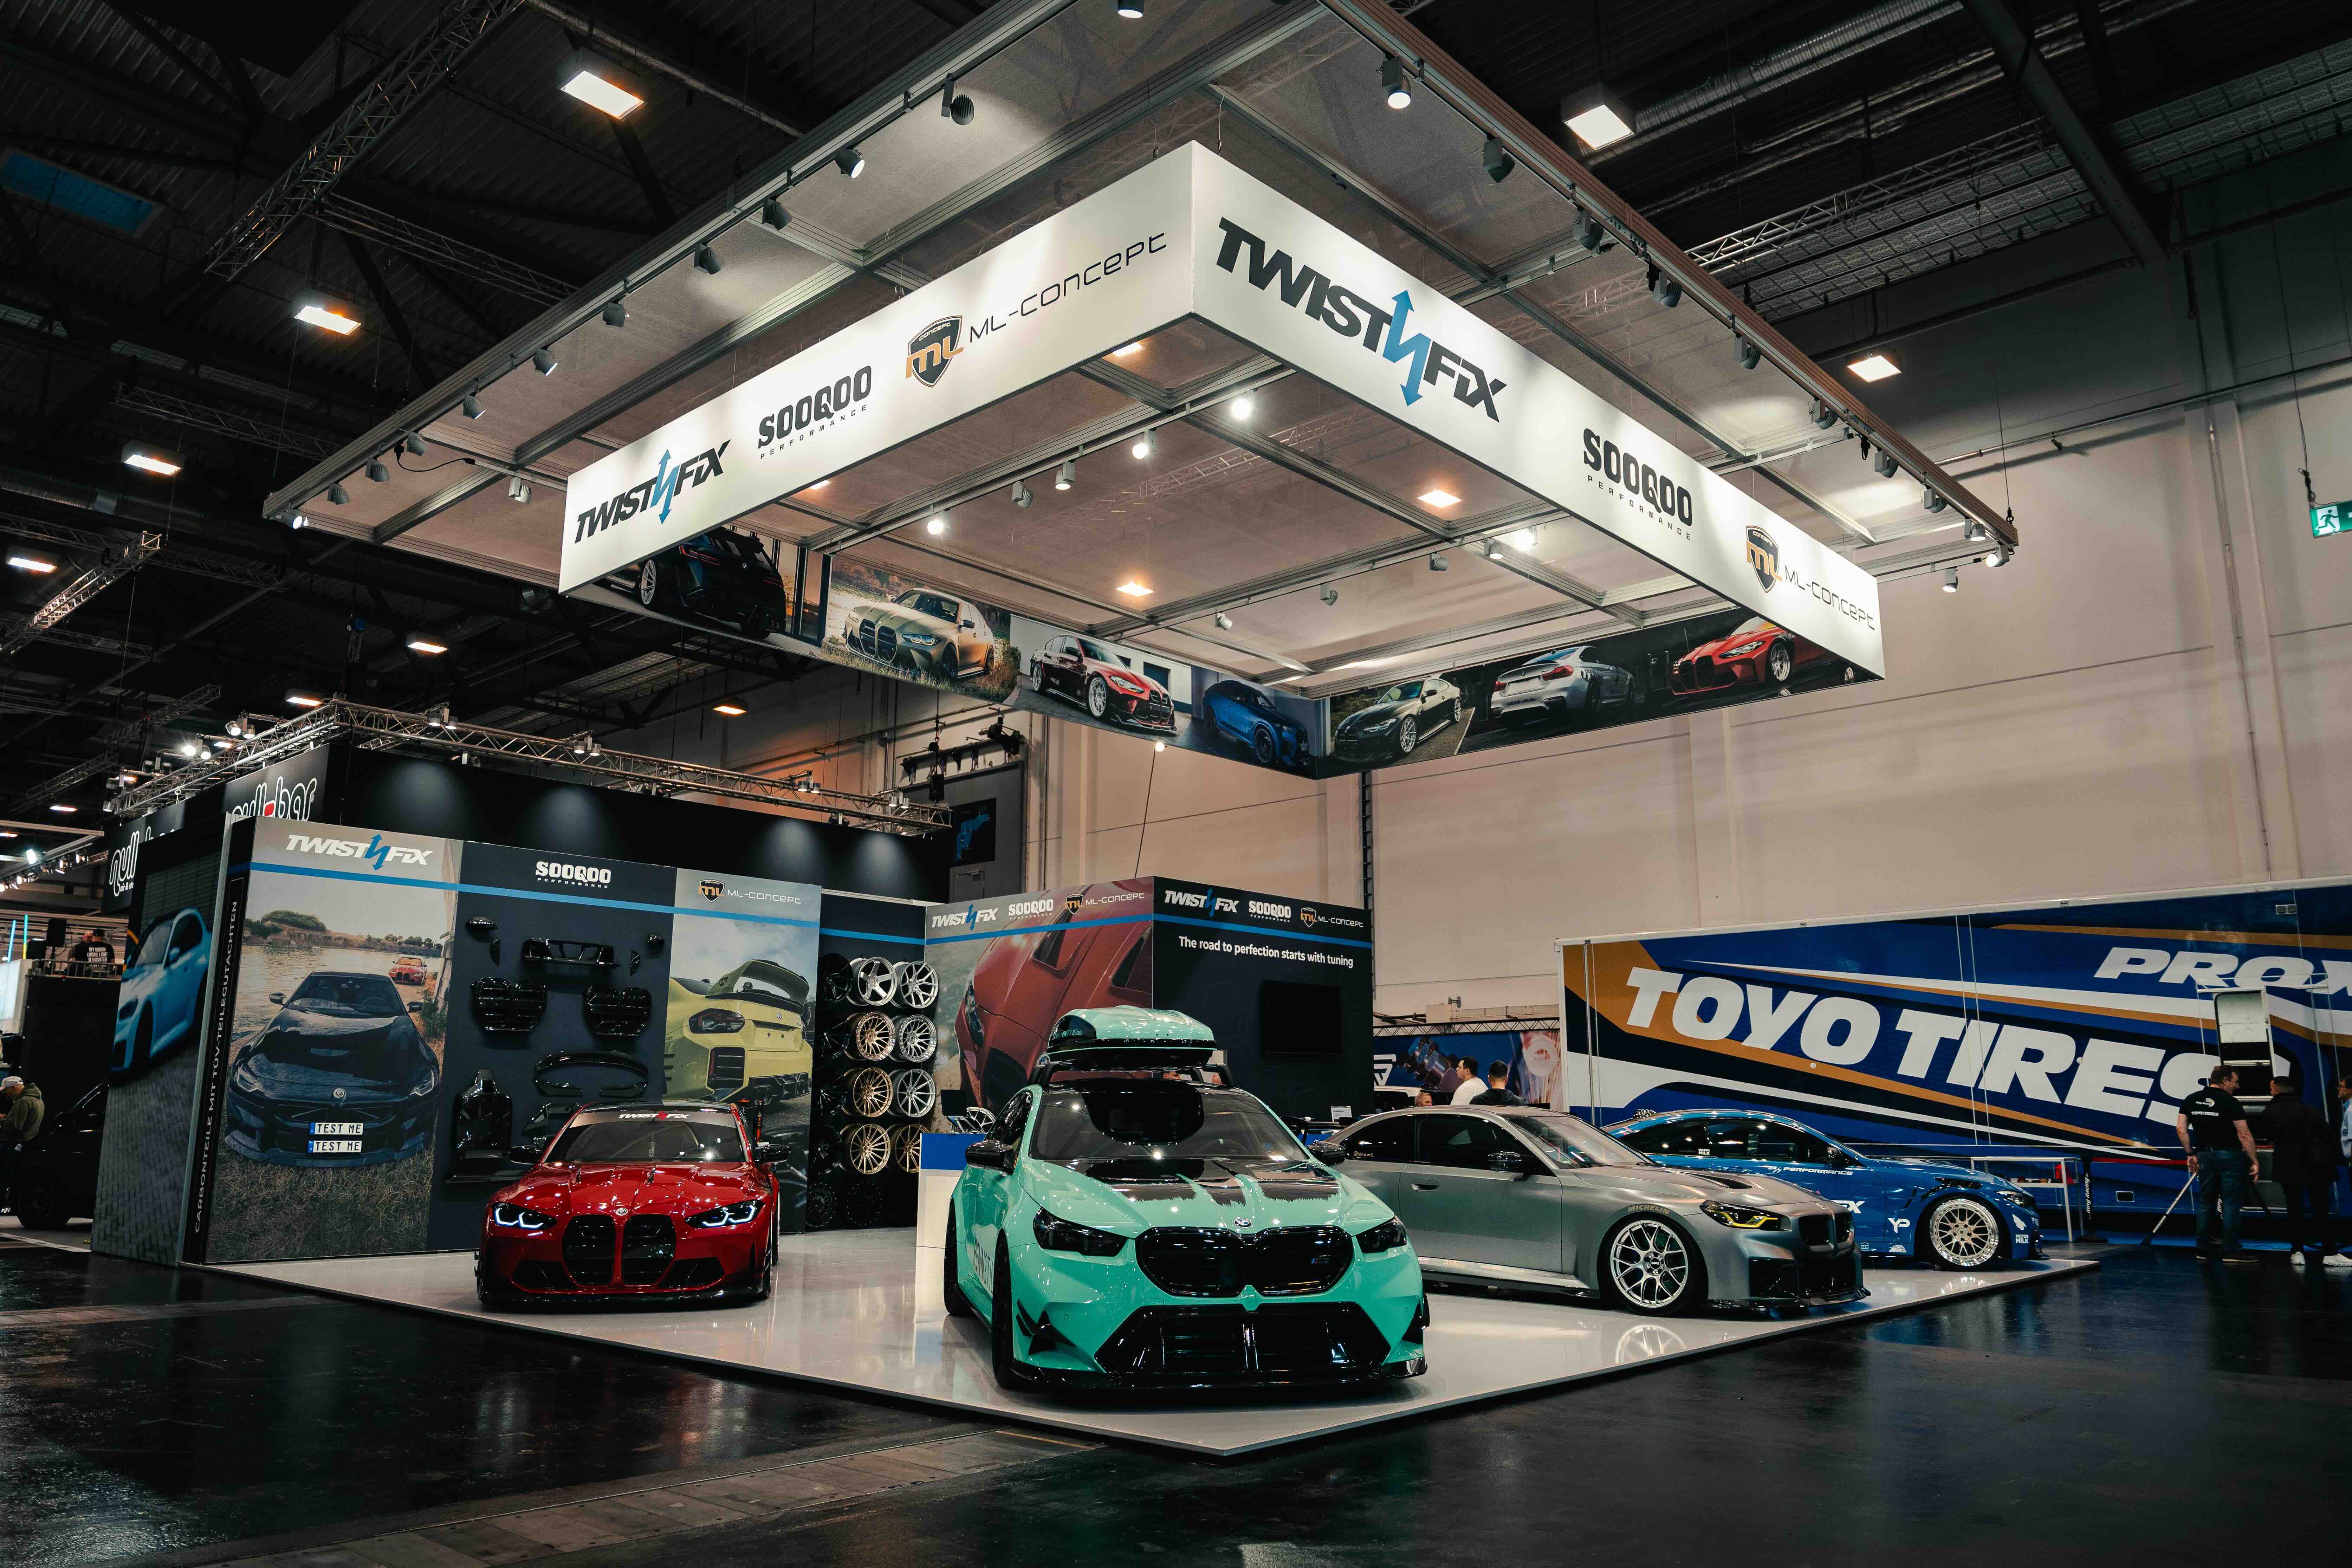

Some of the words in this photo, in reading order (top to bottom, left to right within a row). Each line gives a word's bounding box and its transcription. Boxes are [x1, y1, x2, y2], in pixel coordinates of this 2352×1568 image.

[758, 366, 871, 448] SOOQOO
[761, 405, 866, 459] PERFORMANCE
[1584, 429, 1692, 526] SOOQOO
[1588, 475, 1690, 540] PERFORMANCE
[536, 861, 611, 883] SOOQOO
[538, 878, 607, 888] PERFORMANCE
[1009, 899, 1054, 916] SOOQOO
[1249, 901, 1291, 918] SOOQOO
[1179, 936, 1197, 948] The
[1200, 940, 1220, 951] road
[1223, 942, 1232, 952] to
[1235, 944, 1279, 958] perfection
[1282, 950, 1305, 961] starts
[1307, 952, 1325, 963] with
[1327, 955, 1353, 968] tuning
[1627, 967, 1880, 1064] TOYO
[195, 1116, 212, 1233] CARBONTEILE
[212, 901, 237, 1078] TÜV-TEILEGUTACHTEN
[317, 1124, 343, 1133] TEST
[349, 1124, 362, 1133] ME
[315, 1142, 342, 1151] TEST
[347, 1142, 360, 1151] ME
[1783, 1167, 1854, 1175] PERFORMANCE
[1628, 1204, 1670, 1214] MICHELIN
